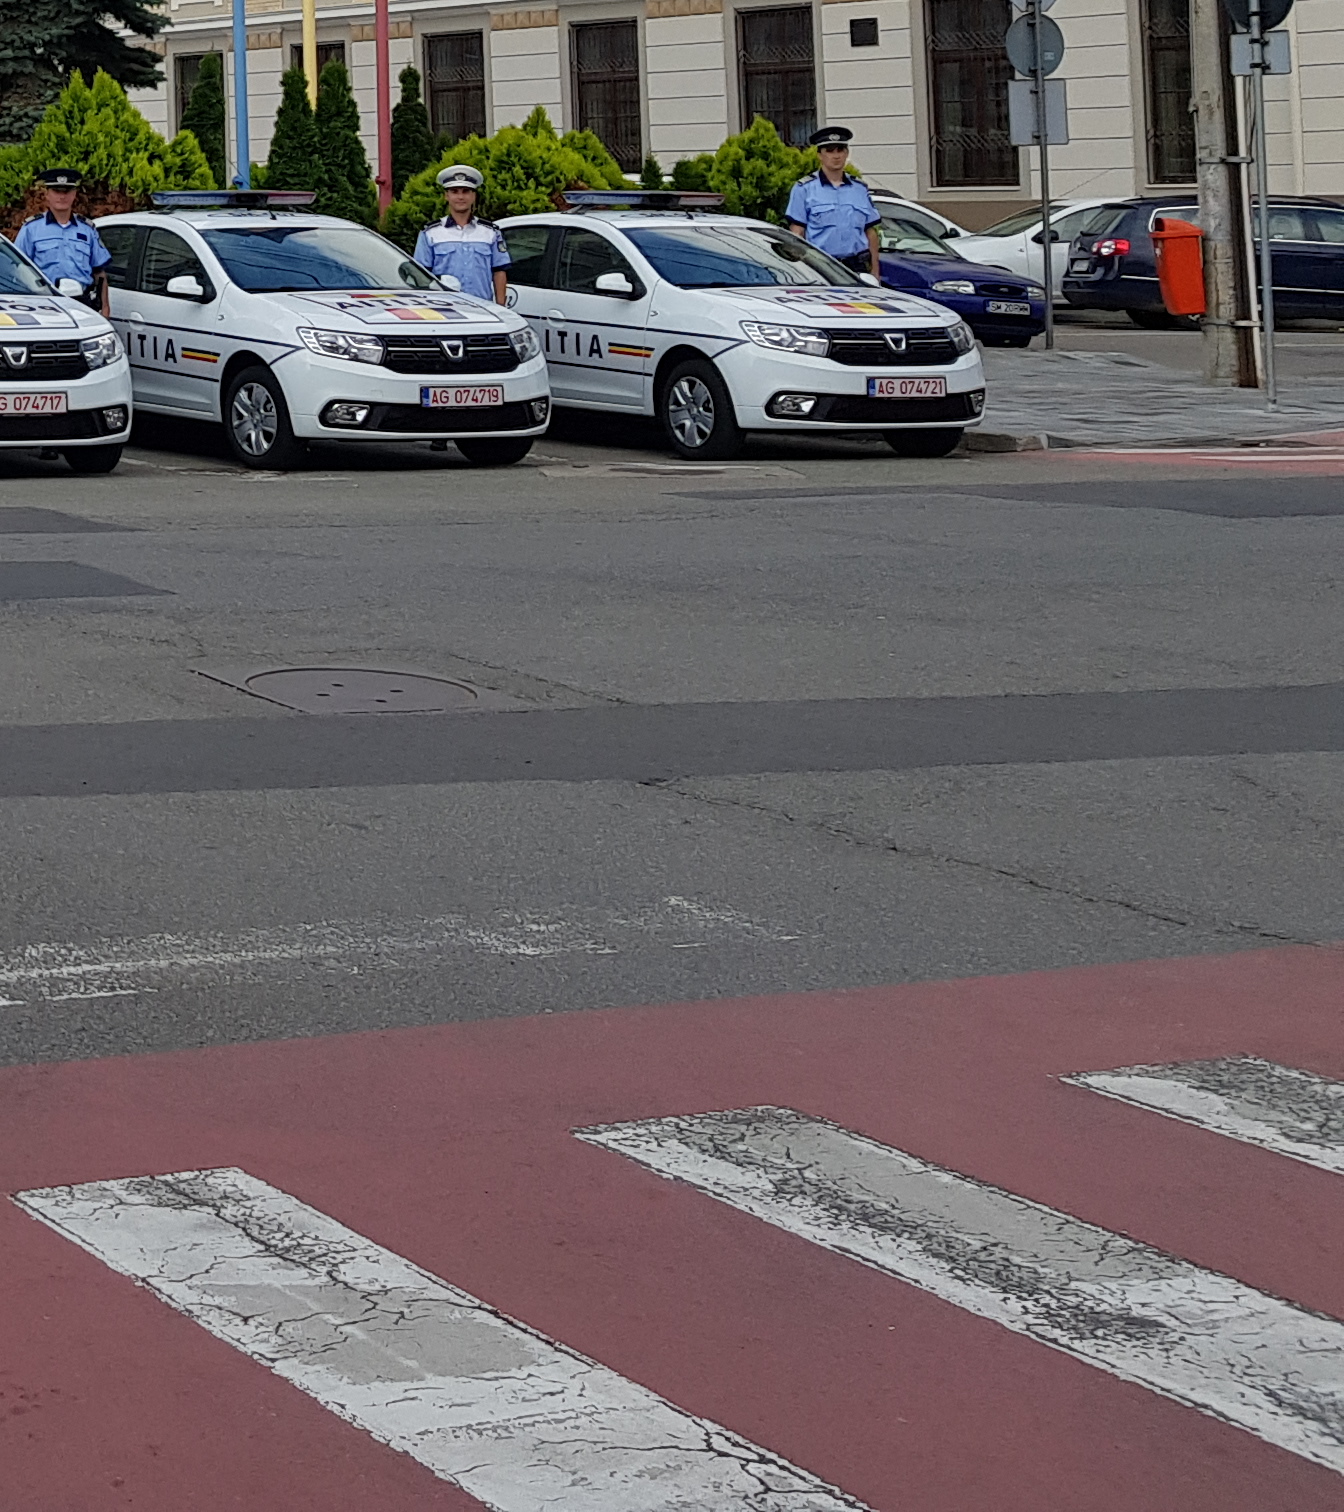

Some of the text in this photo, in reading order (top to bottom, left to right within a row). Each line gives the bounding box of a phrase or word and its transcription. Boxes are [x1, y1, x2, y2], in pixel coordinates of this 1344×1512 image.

[127, 332, 177, 363] ITIA
[545, 329, 603, 359] ITIA
[877, 380, 943, 395] AG 074721
[13, 395, 62, 411] 074717
[431, 388, 499, 404] AG 074719
